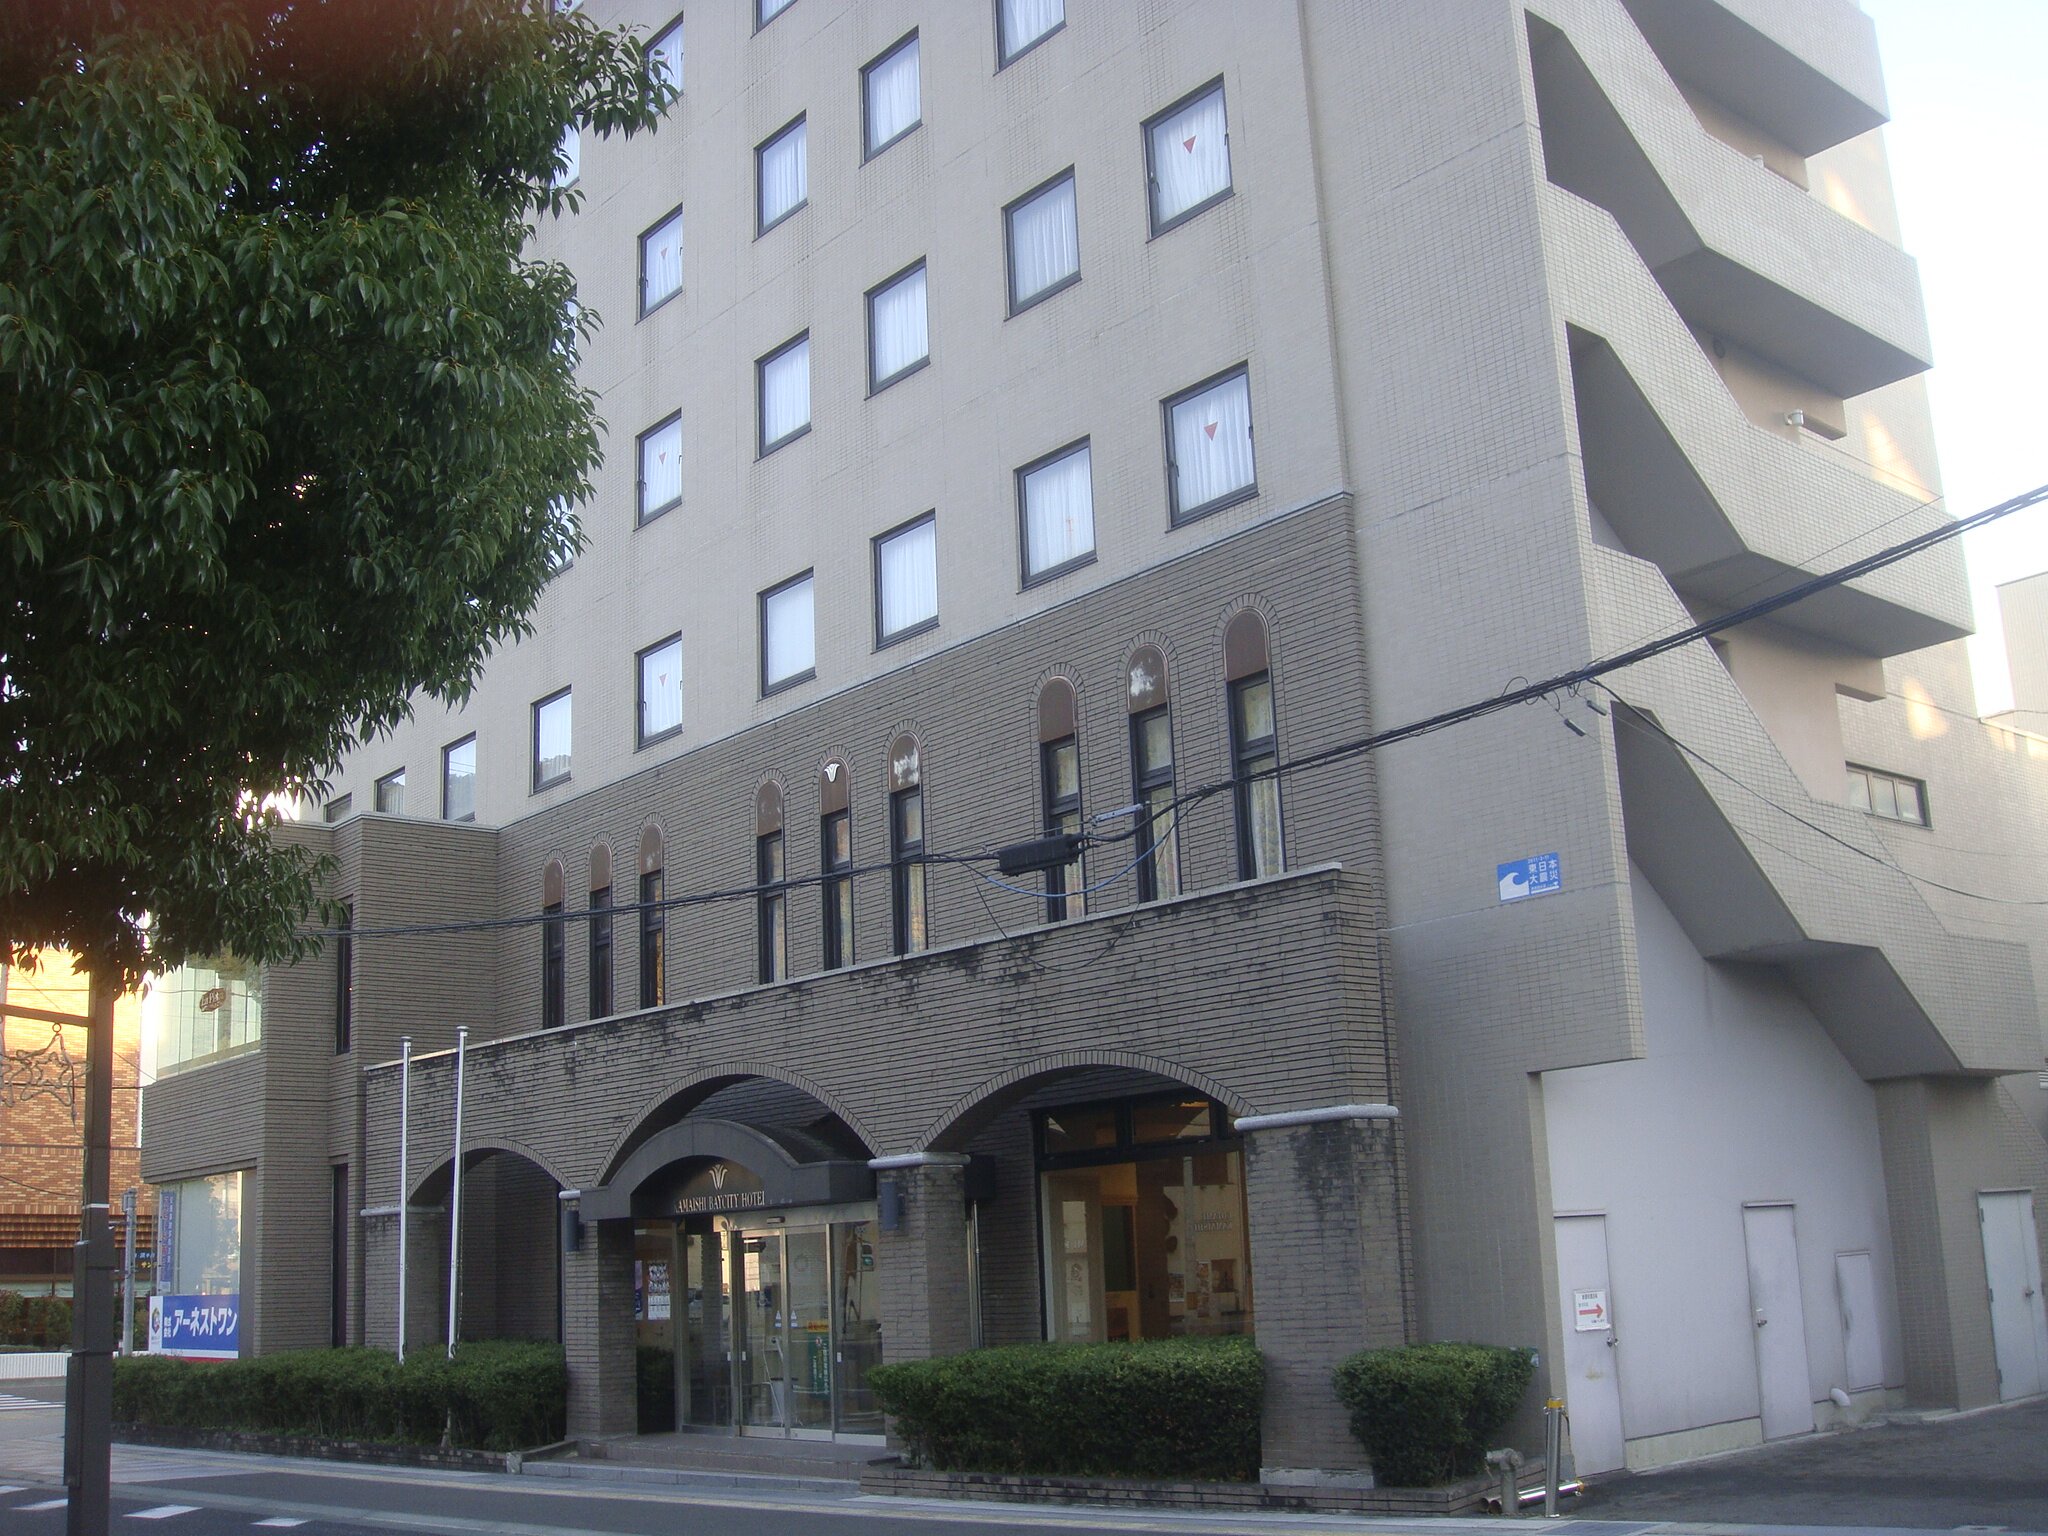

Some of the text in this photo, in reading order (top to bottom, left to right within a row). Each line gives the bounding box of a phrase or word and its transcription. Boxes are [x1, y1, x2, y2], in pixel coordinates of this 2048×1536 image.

[676, 1197, 707, 1213] AMAISHI
[709, 1193, 740, 1210] BAYCITY
[172, 1306, 238, 1338] アーネストワン
